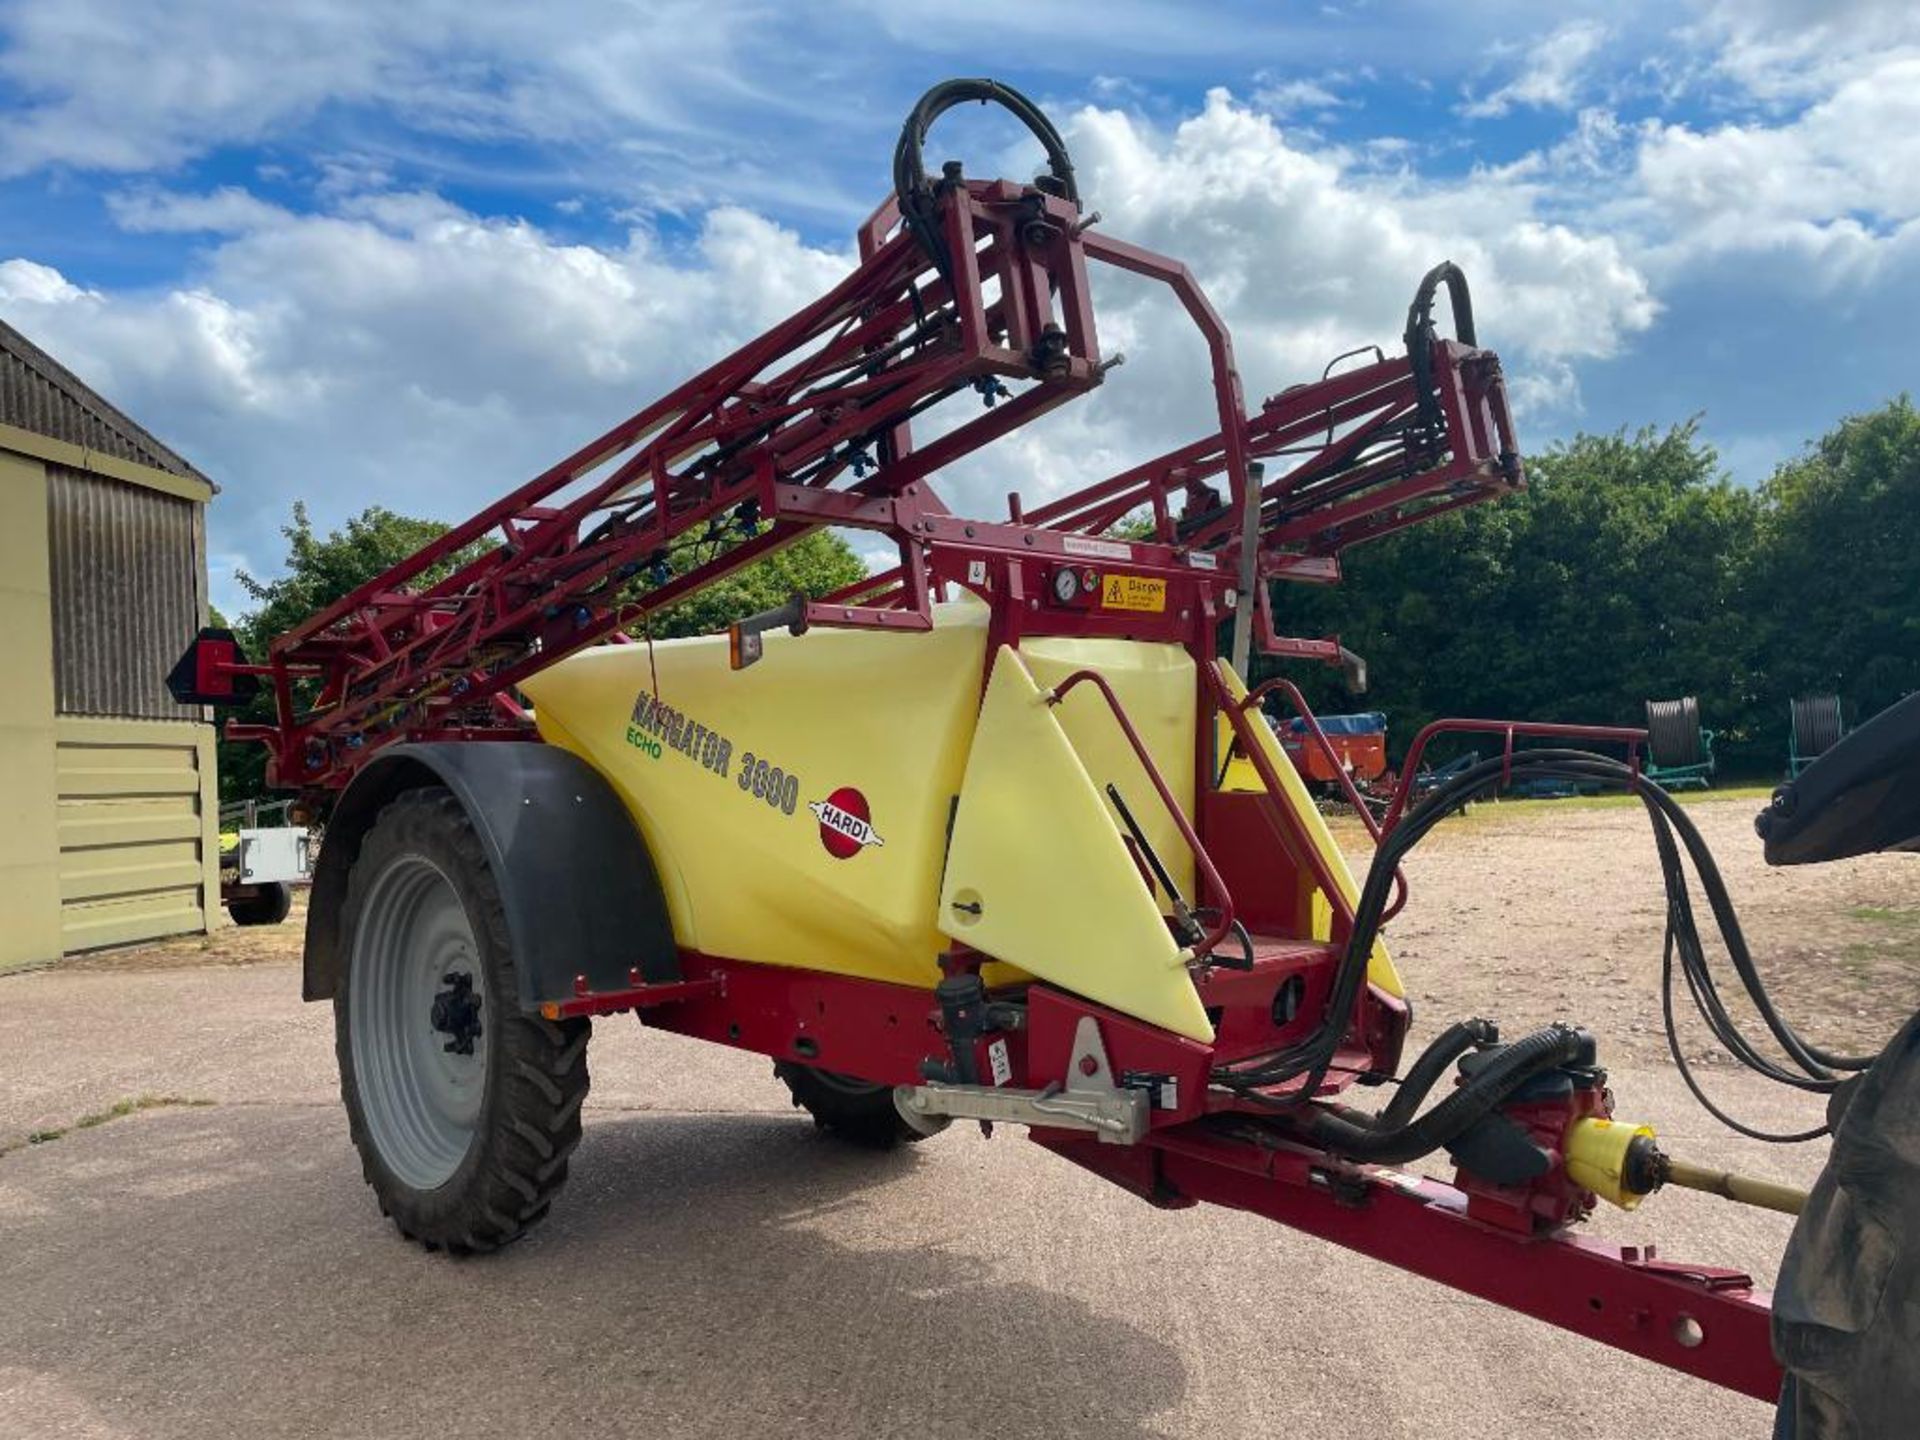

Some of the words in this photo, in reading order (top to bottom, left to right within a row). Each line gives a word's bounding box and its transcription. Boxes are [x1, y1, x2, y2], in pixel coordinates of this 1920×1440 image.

[626, 727, 662, 759] ECHO
[631, 690, 733, 778] NAVIGATOR
[738, 752, 799, 816] 3000
[822, 805, 869, 841] HARDI
